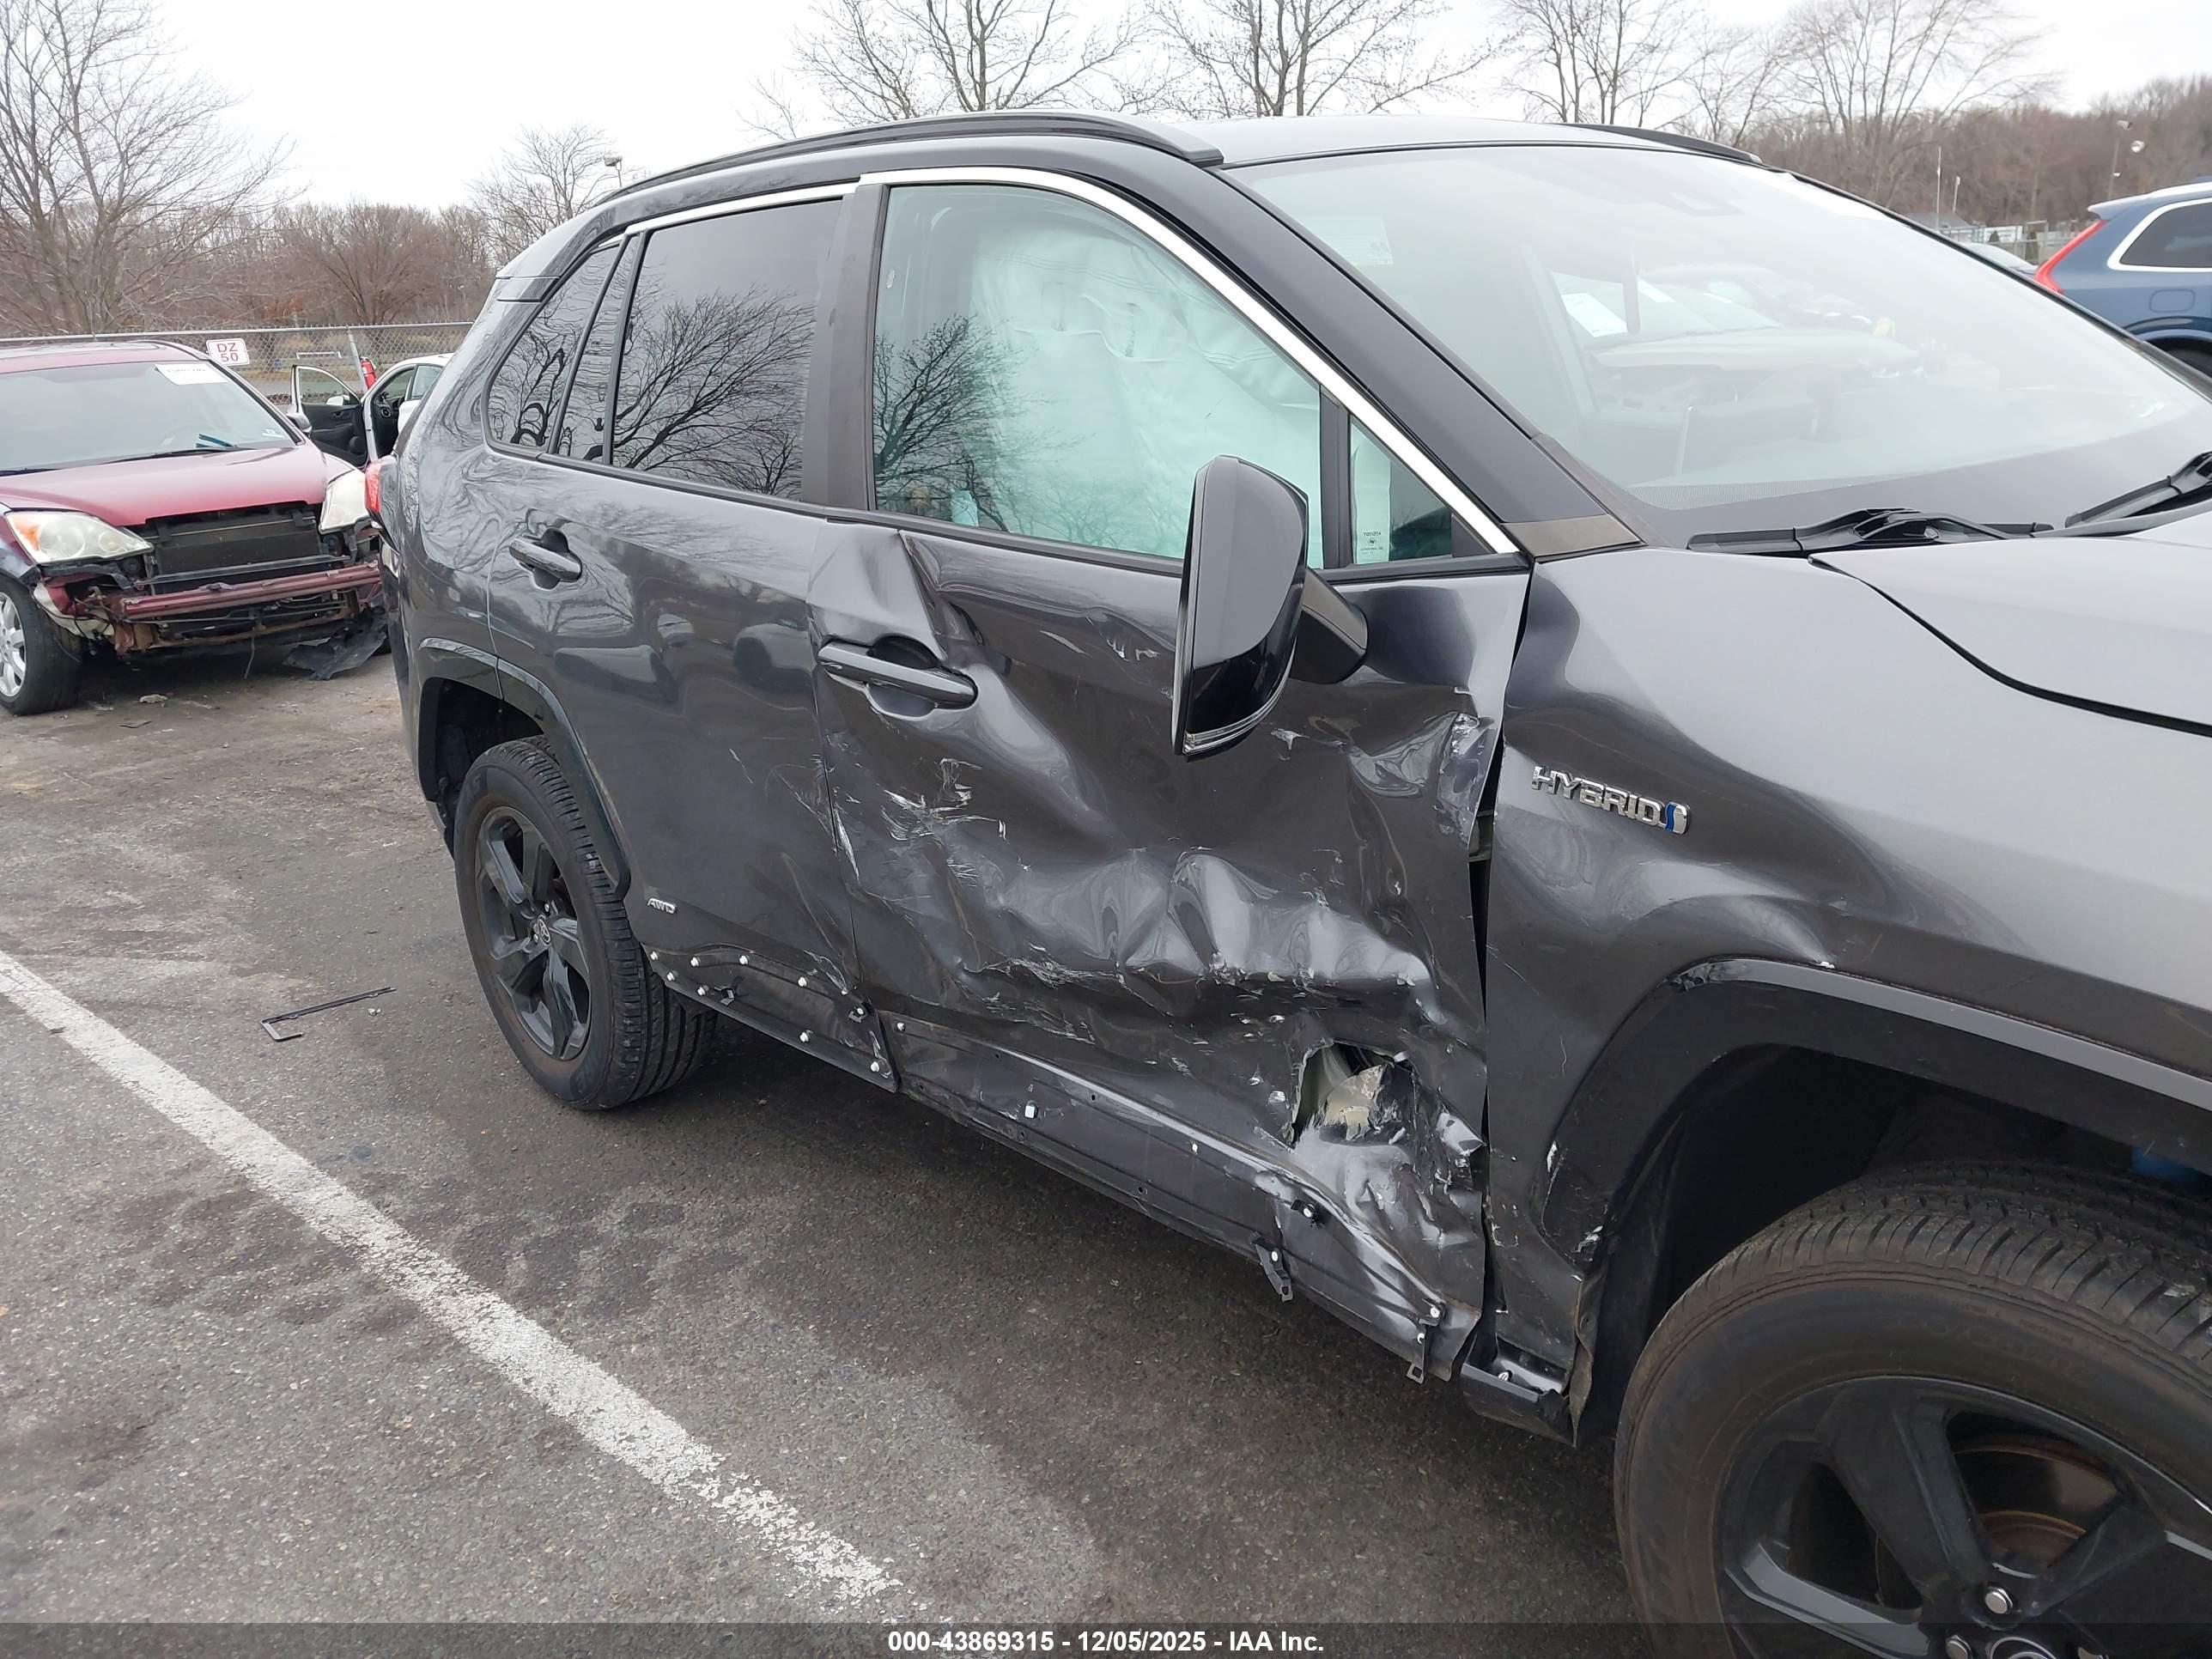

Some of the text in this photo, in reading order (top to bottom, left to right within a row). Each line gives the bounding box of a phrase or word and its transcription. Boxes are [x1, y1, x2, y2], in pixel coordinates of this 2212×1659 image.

[216, 343, 238, 352] DZ
[221, 352, 238, 362] 50
[1532, 766, 1663, 826] HYBRID
[647, 897, 677, 915] AWD
